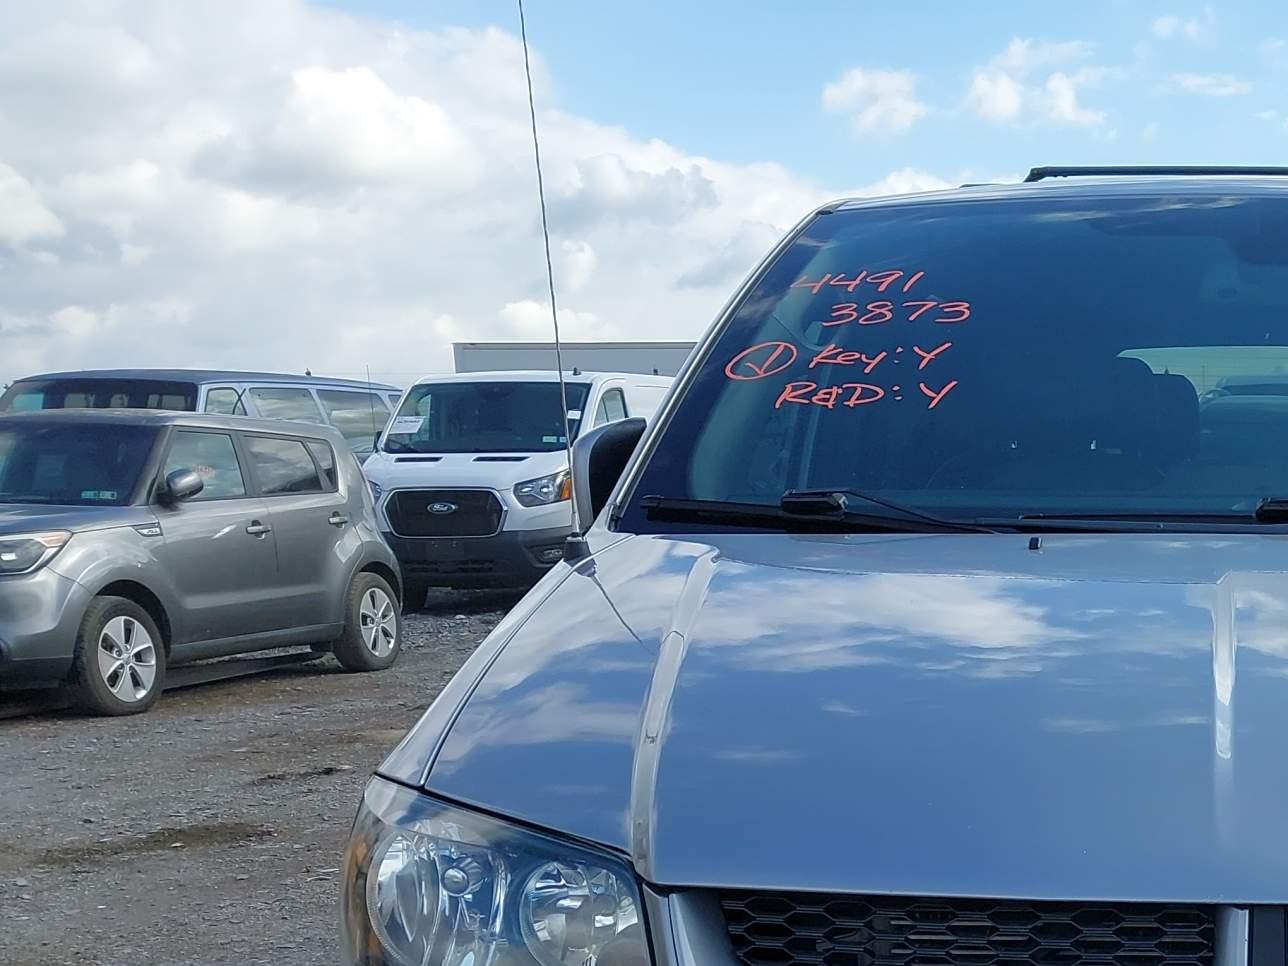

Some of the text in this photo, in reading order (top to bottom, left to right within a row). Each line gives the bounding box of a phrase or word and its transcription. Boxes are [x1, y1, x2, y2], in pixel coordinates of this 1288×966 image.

[790, 271, 925, 294] 4491
[822, 301, 971, 326] 3873
[913, 343, 952, 370] Y
[919, 381, 959, 409] Y
